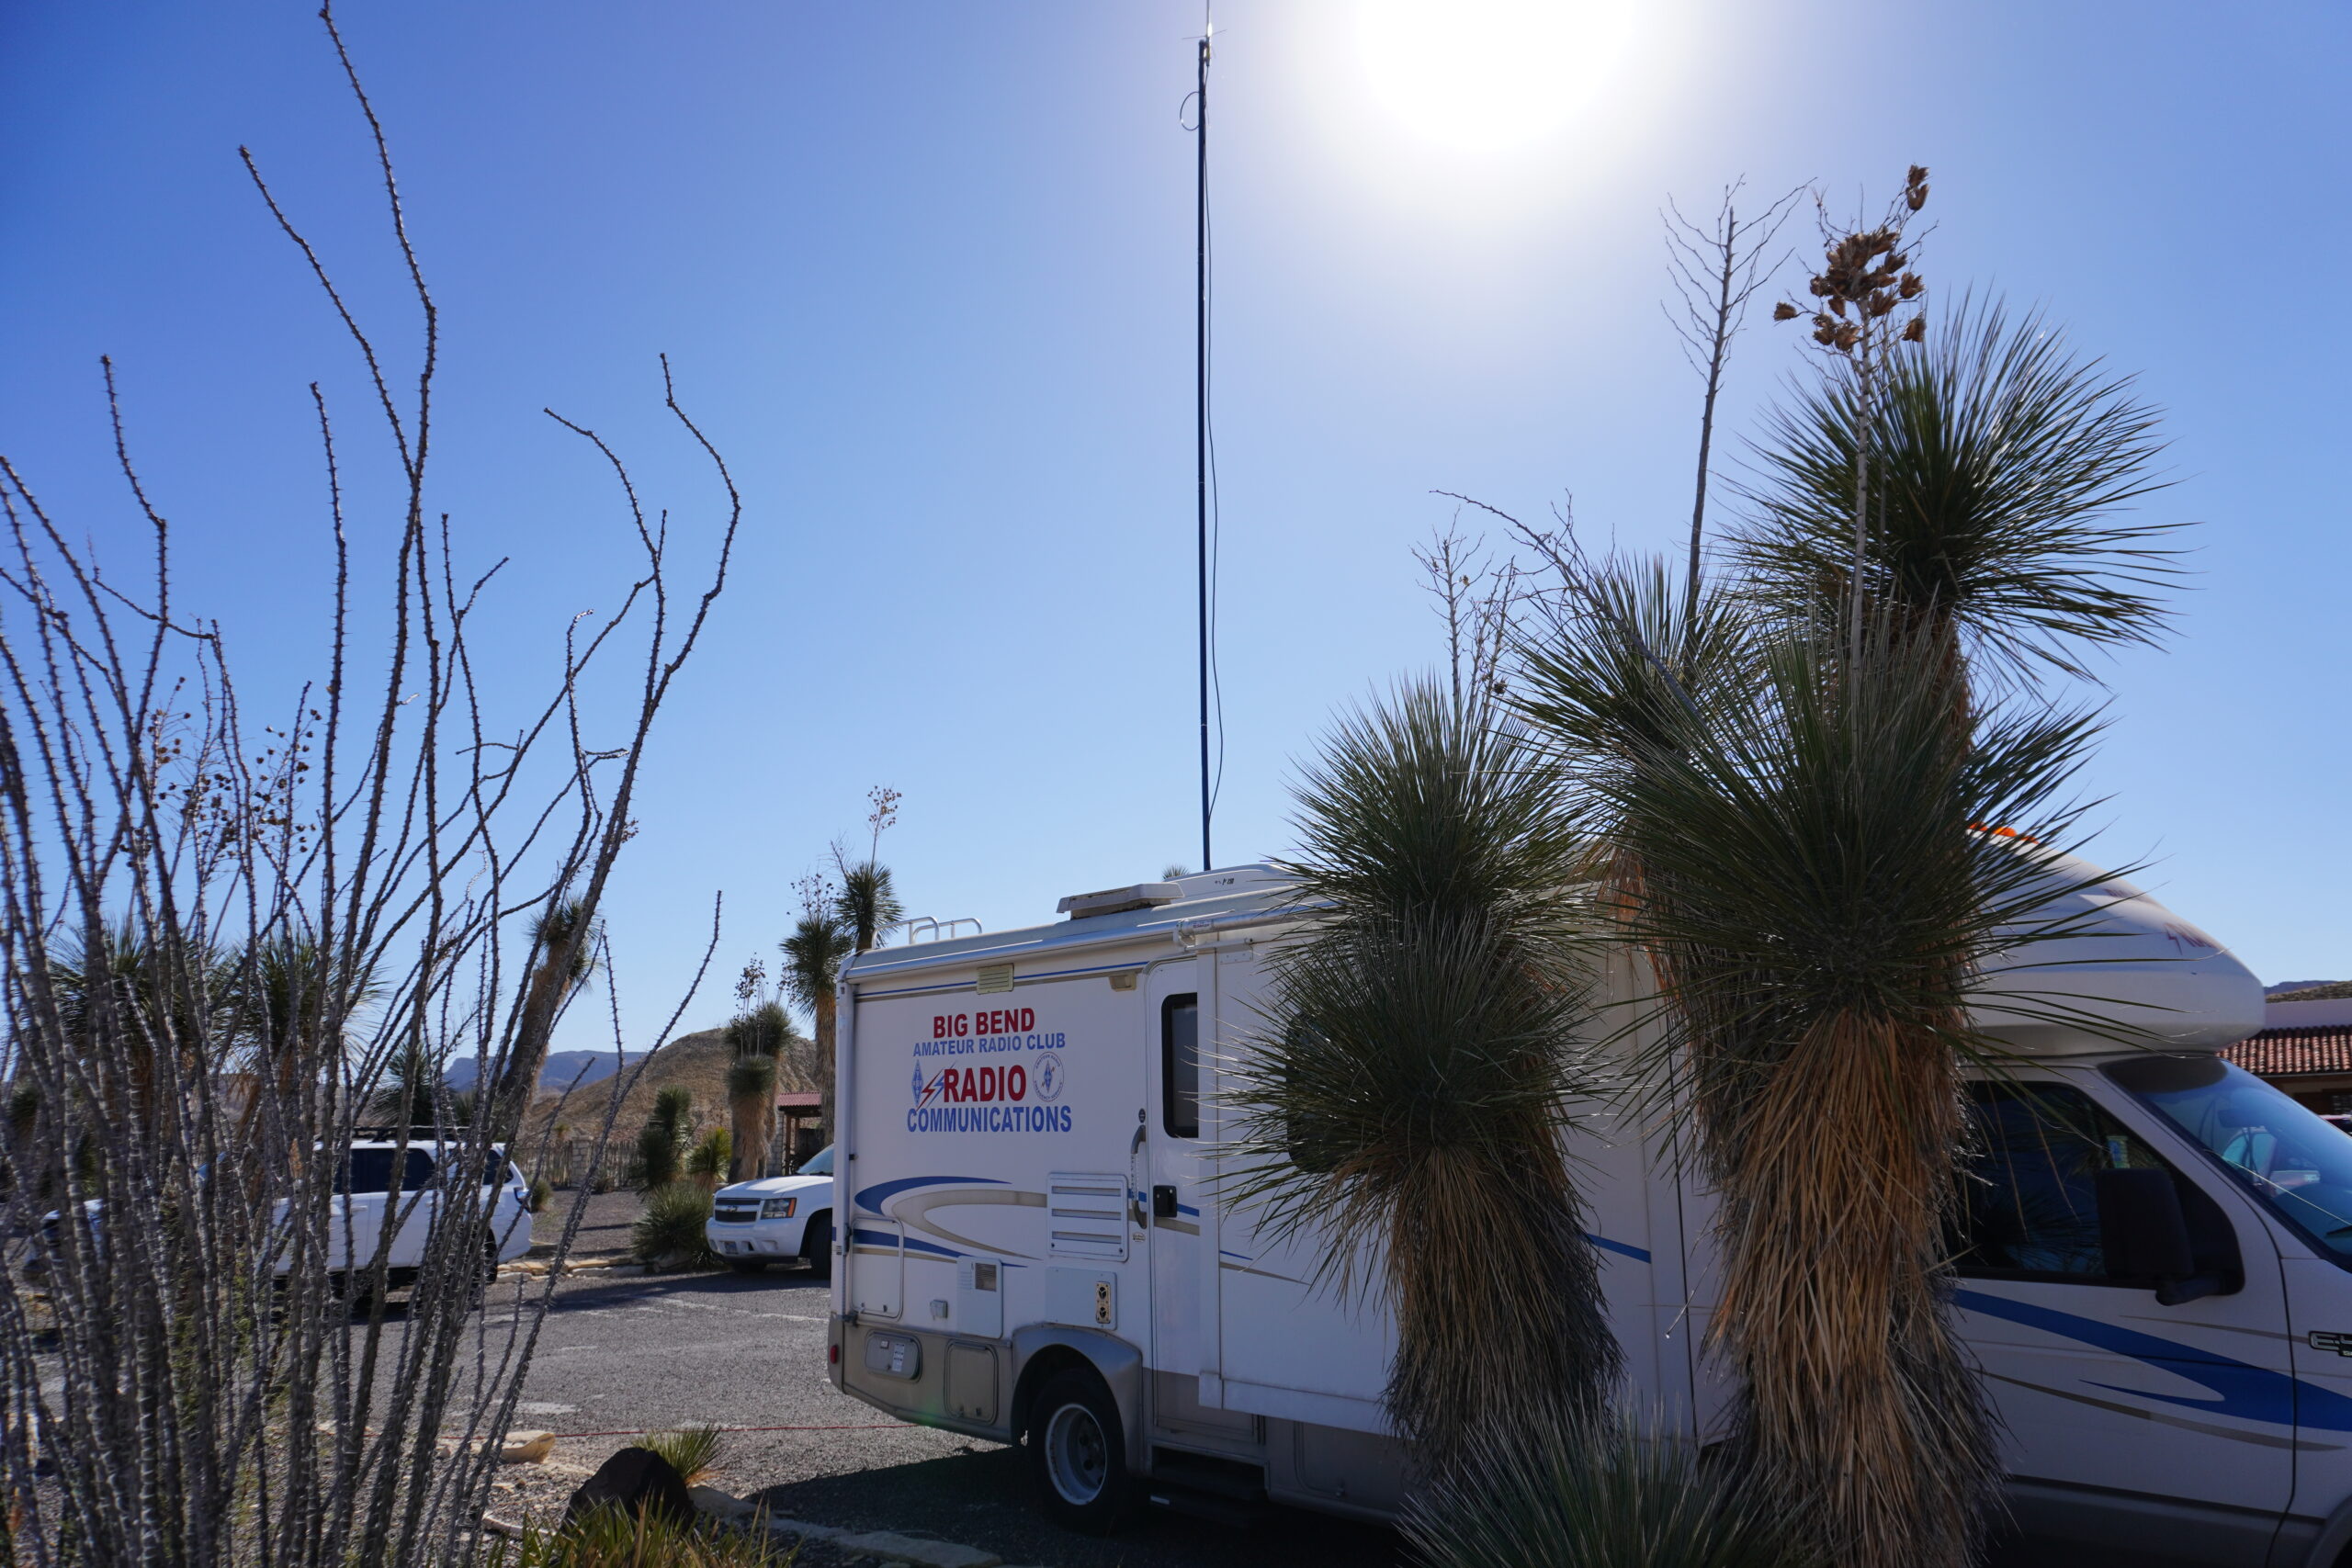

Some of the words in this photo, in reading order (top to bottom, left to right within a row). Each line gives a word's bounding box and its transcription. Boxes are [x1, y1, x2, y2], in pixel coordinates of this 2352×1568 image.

[933, 1013, 968, 1039] BIG
[976, 1008, 1035, 1035] BEND
[913, 1039, 974, 1057] AMATEUR
[978, 1035, 1022, 1054] RADIO
[1026, 1032, 1066, 1051] CLUB
[944, 1065, 1027, 1103] RADIO
[907, 1105, 1072, 1133] COMMUNICATIONS
